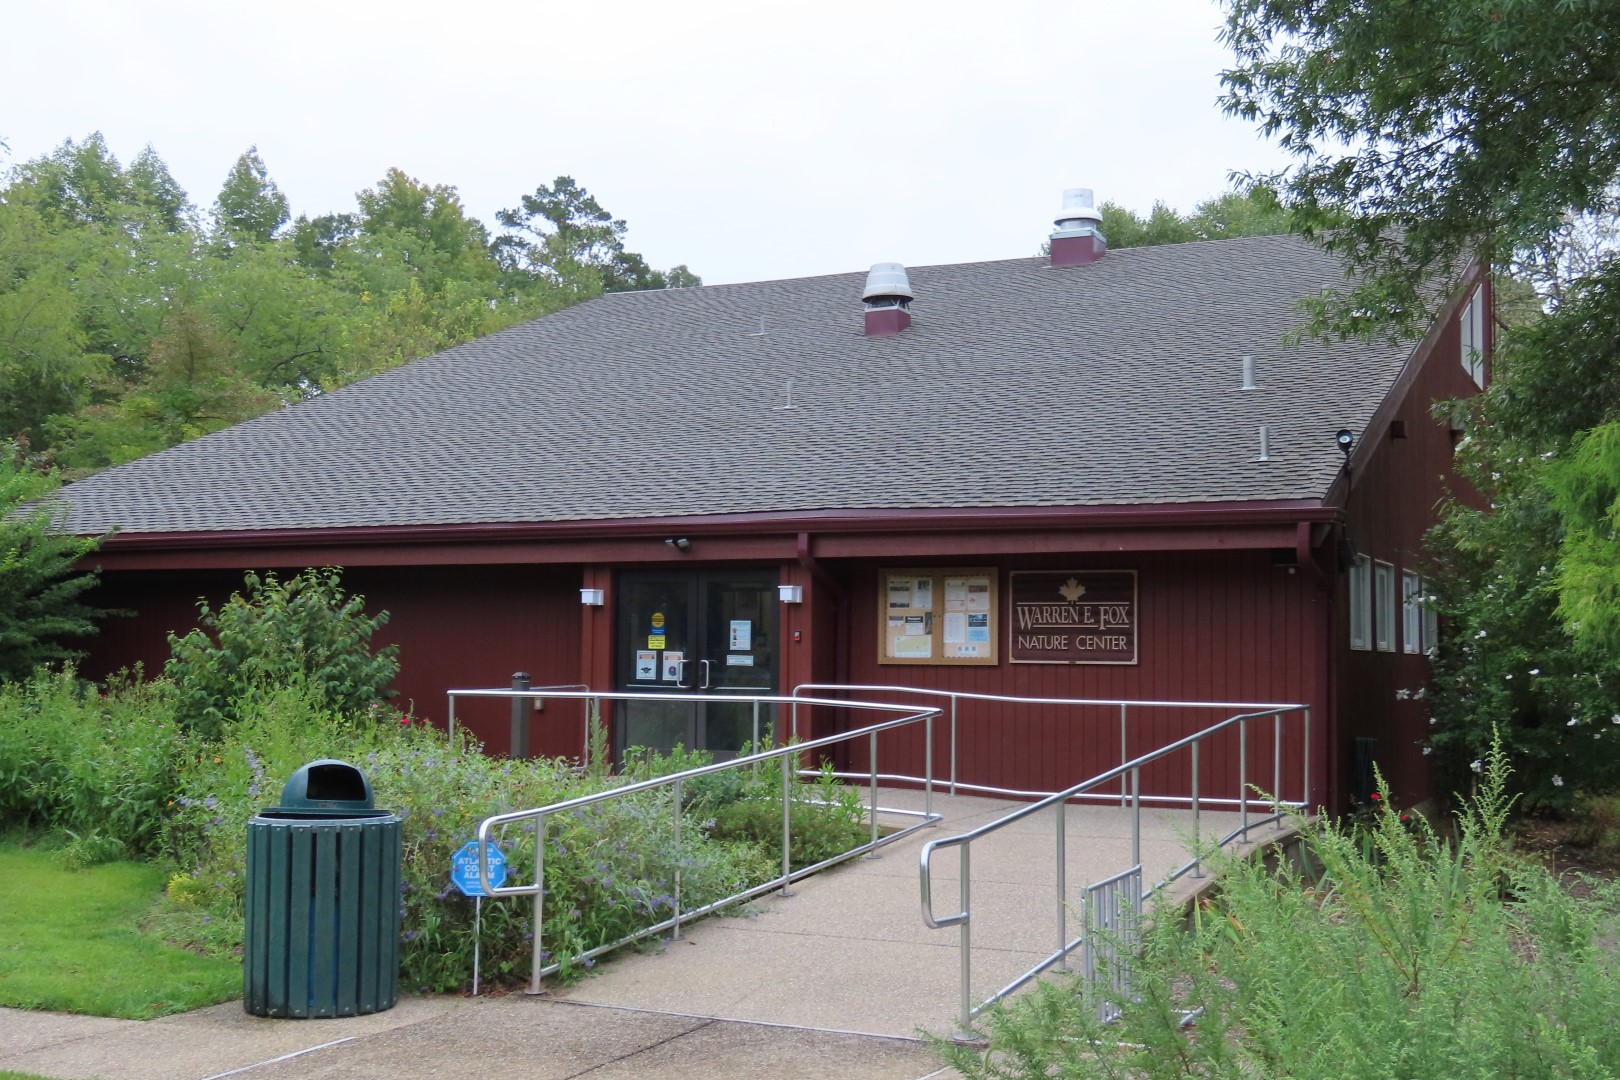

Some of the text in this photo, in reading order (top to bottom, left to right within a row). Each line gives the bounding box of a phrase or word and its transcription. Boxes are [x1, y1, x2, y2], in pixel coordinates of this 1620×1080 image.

[1016, 606, 1079, 630] WARREN
[1084, 606, 1095, 624] E.
[1098, 606, 1130, 630] FOX
[1018, 635, 1127, 650] NATURE CENTER
[458, 857, 502, 865] ATLATIC
